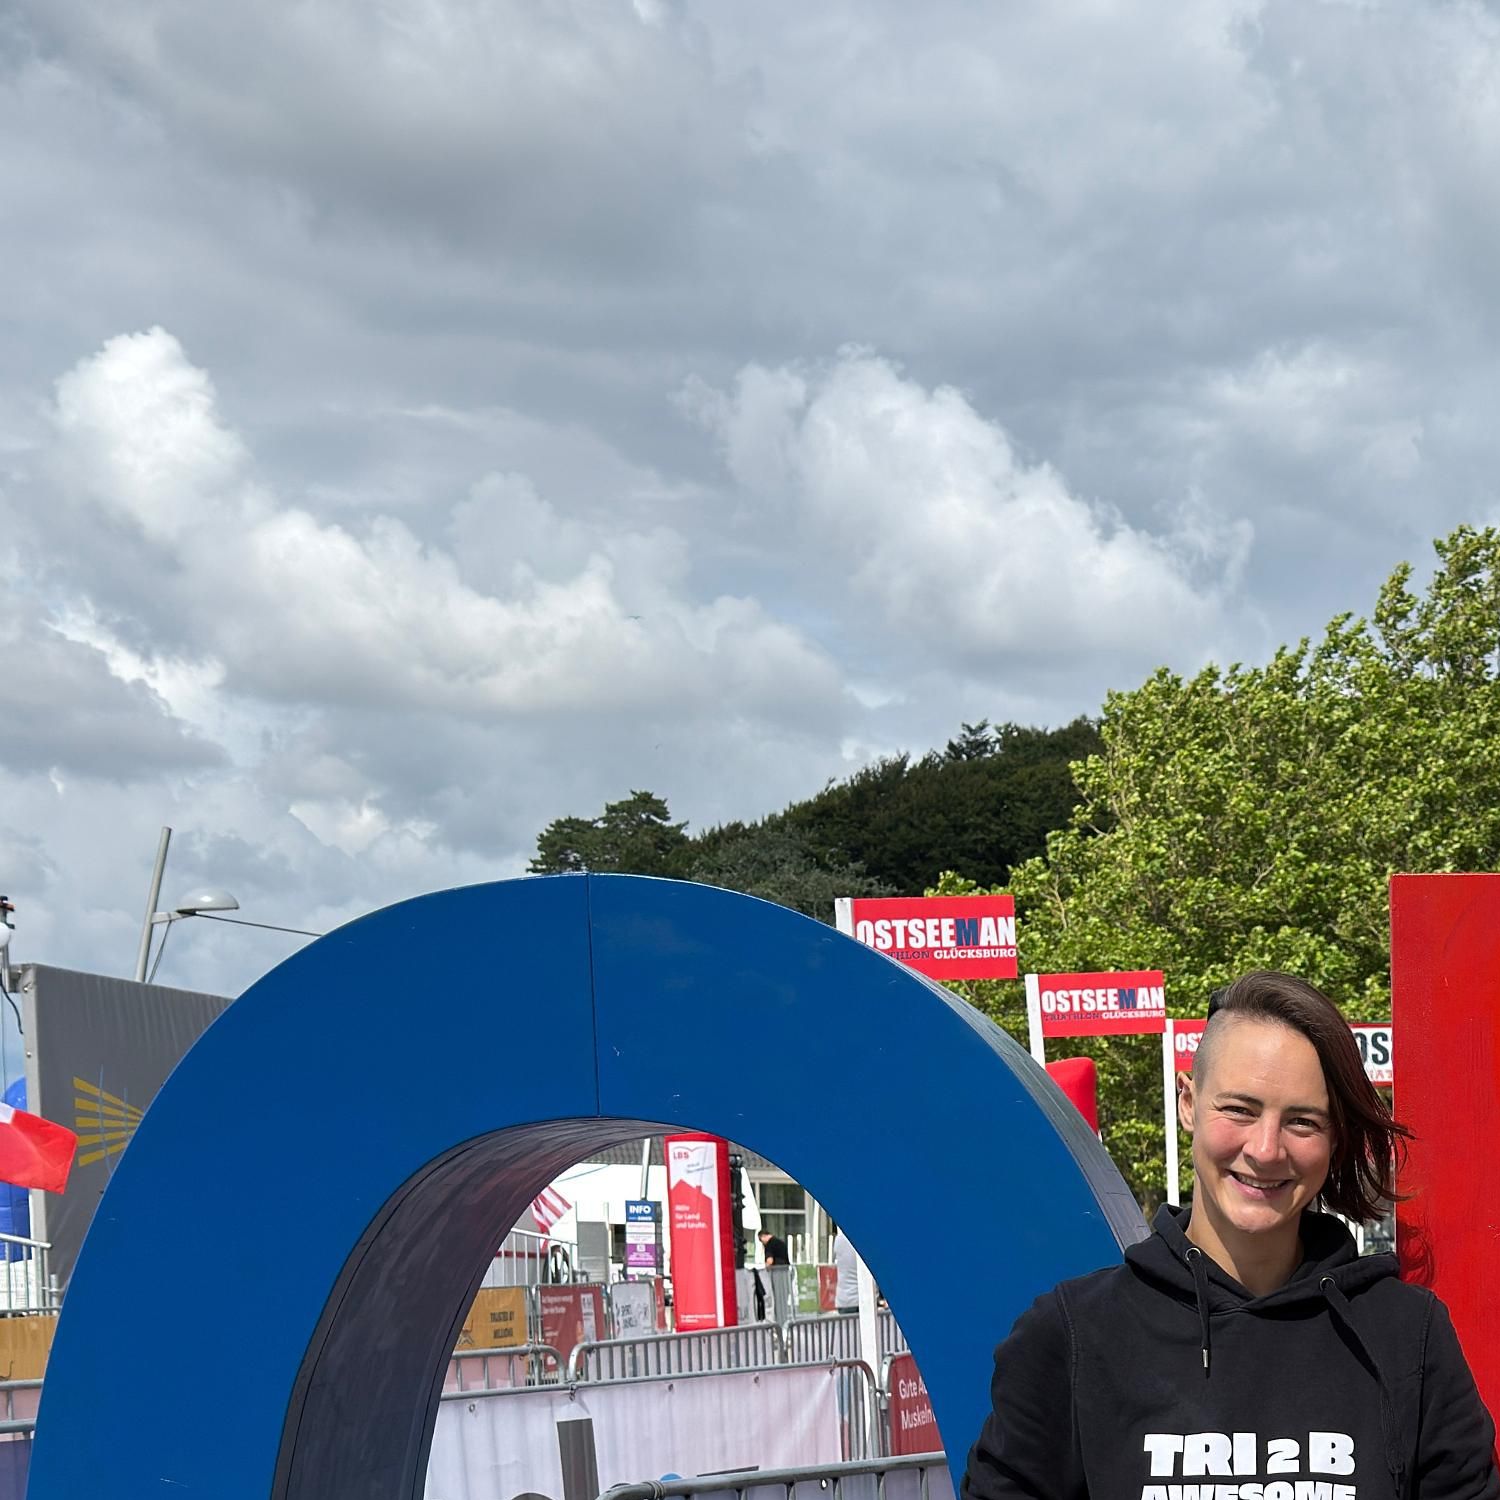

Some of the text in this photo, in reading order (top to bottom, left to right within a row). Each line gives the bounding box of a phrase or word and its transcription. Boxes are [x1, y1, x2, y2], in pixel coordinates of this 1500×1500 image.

[856, 917, 1017, 950] OSTSEEMAN
[886, 948, 1017, 961] THLON GLÜCKSBURG
[1041, 986, 1165, 1014] OSTSEEMAN
[629, 1205, 652, 1214] INFO
[899, 1379, 917, 1399] Gute
[901, 1403, 932, 1430] Muskeln
[1144, 1431, 1356, 1477] TRI 2 B
